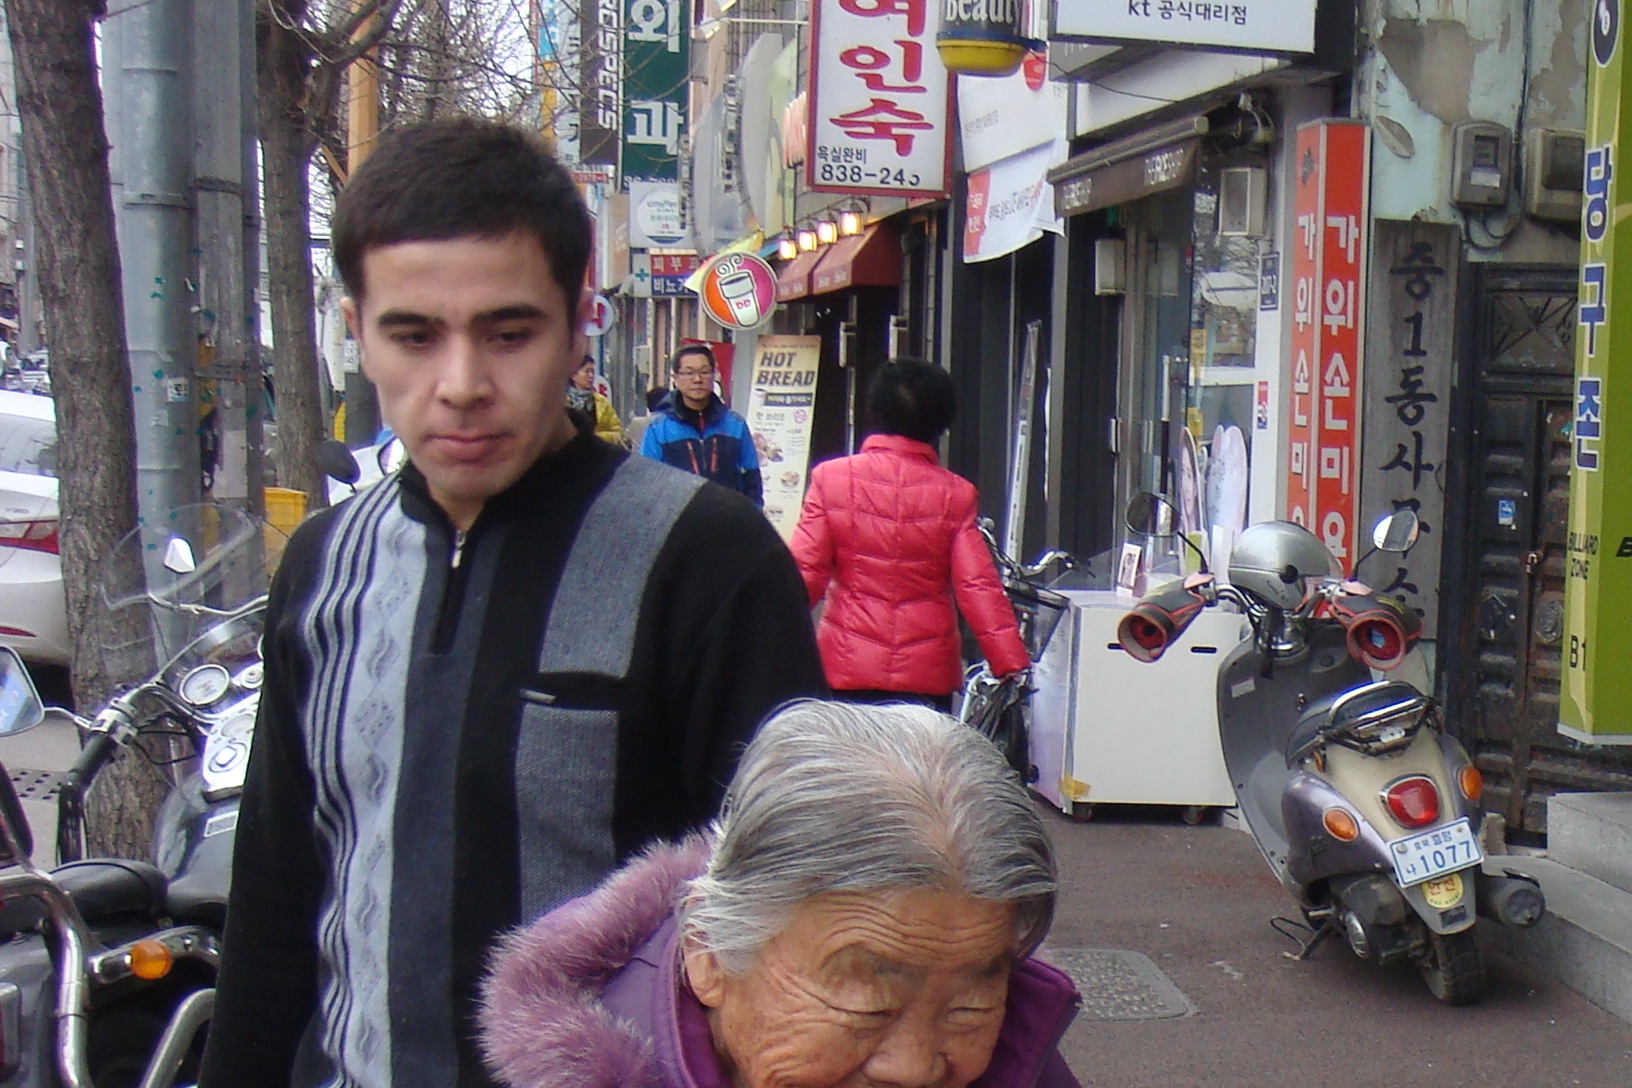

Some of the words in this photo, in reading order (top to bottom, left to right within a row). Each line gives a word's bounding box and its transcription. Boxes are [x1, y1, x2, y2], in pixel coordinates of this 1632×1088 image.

[1158, 2, 1247, 25] 공식대리점
[818, 146, 867, 164] 욕실완비
[1575, 143, 1613, 473] 당구존
[760, 352, 798, 368] HOT
[756, 370, 816, 387] BREAD
[1321, 214, 1360, 576] 가위손미용
[1420, 840, 1471, 874] 1077
